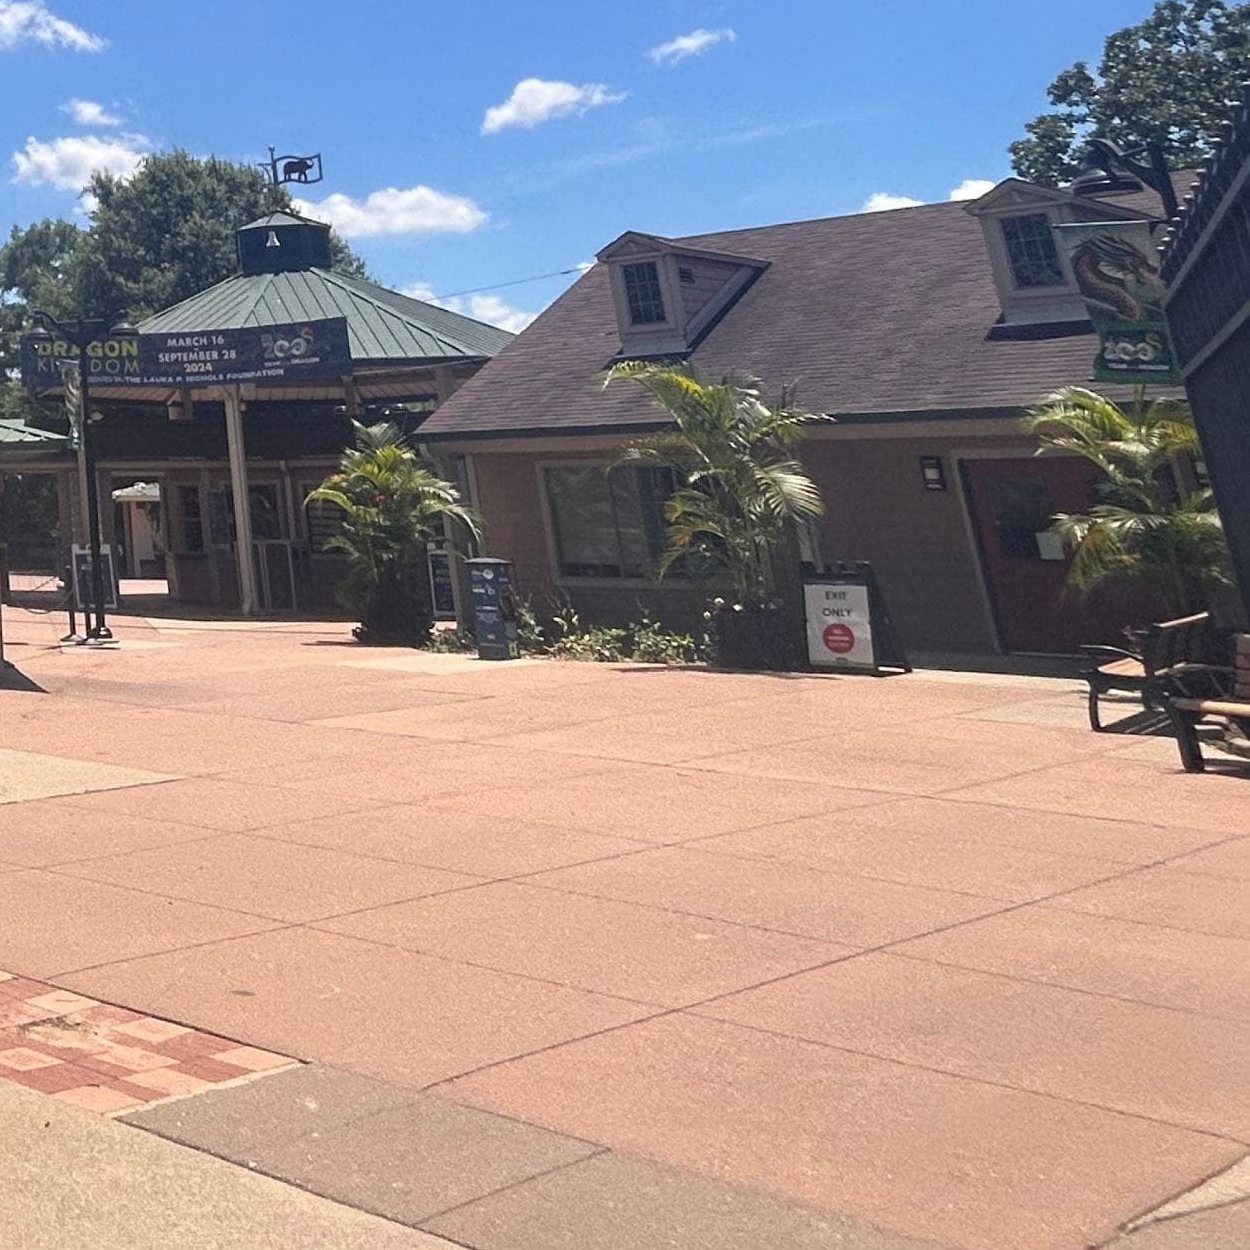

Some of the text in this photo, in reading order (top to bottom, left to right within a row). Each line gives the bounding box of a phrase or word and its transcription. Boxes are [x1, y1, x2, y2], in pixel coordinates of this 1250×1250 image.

[166, 335, 225, 347] MARCH 16
[158, 350, 237, 363] SEPTEMBER 28
[37, 358, 140, 374] KIDOM
[184, 362, 213, 373] 2024
[825, 591, 847, 600] EXIT
[822, 608, 852, 617] ONLY
